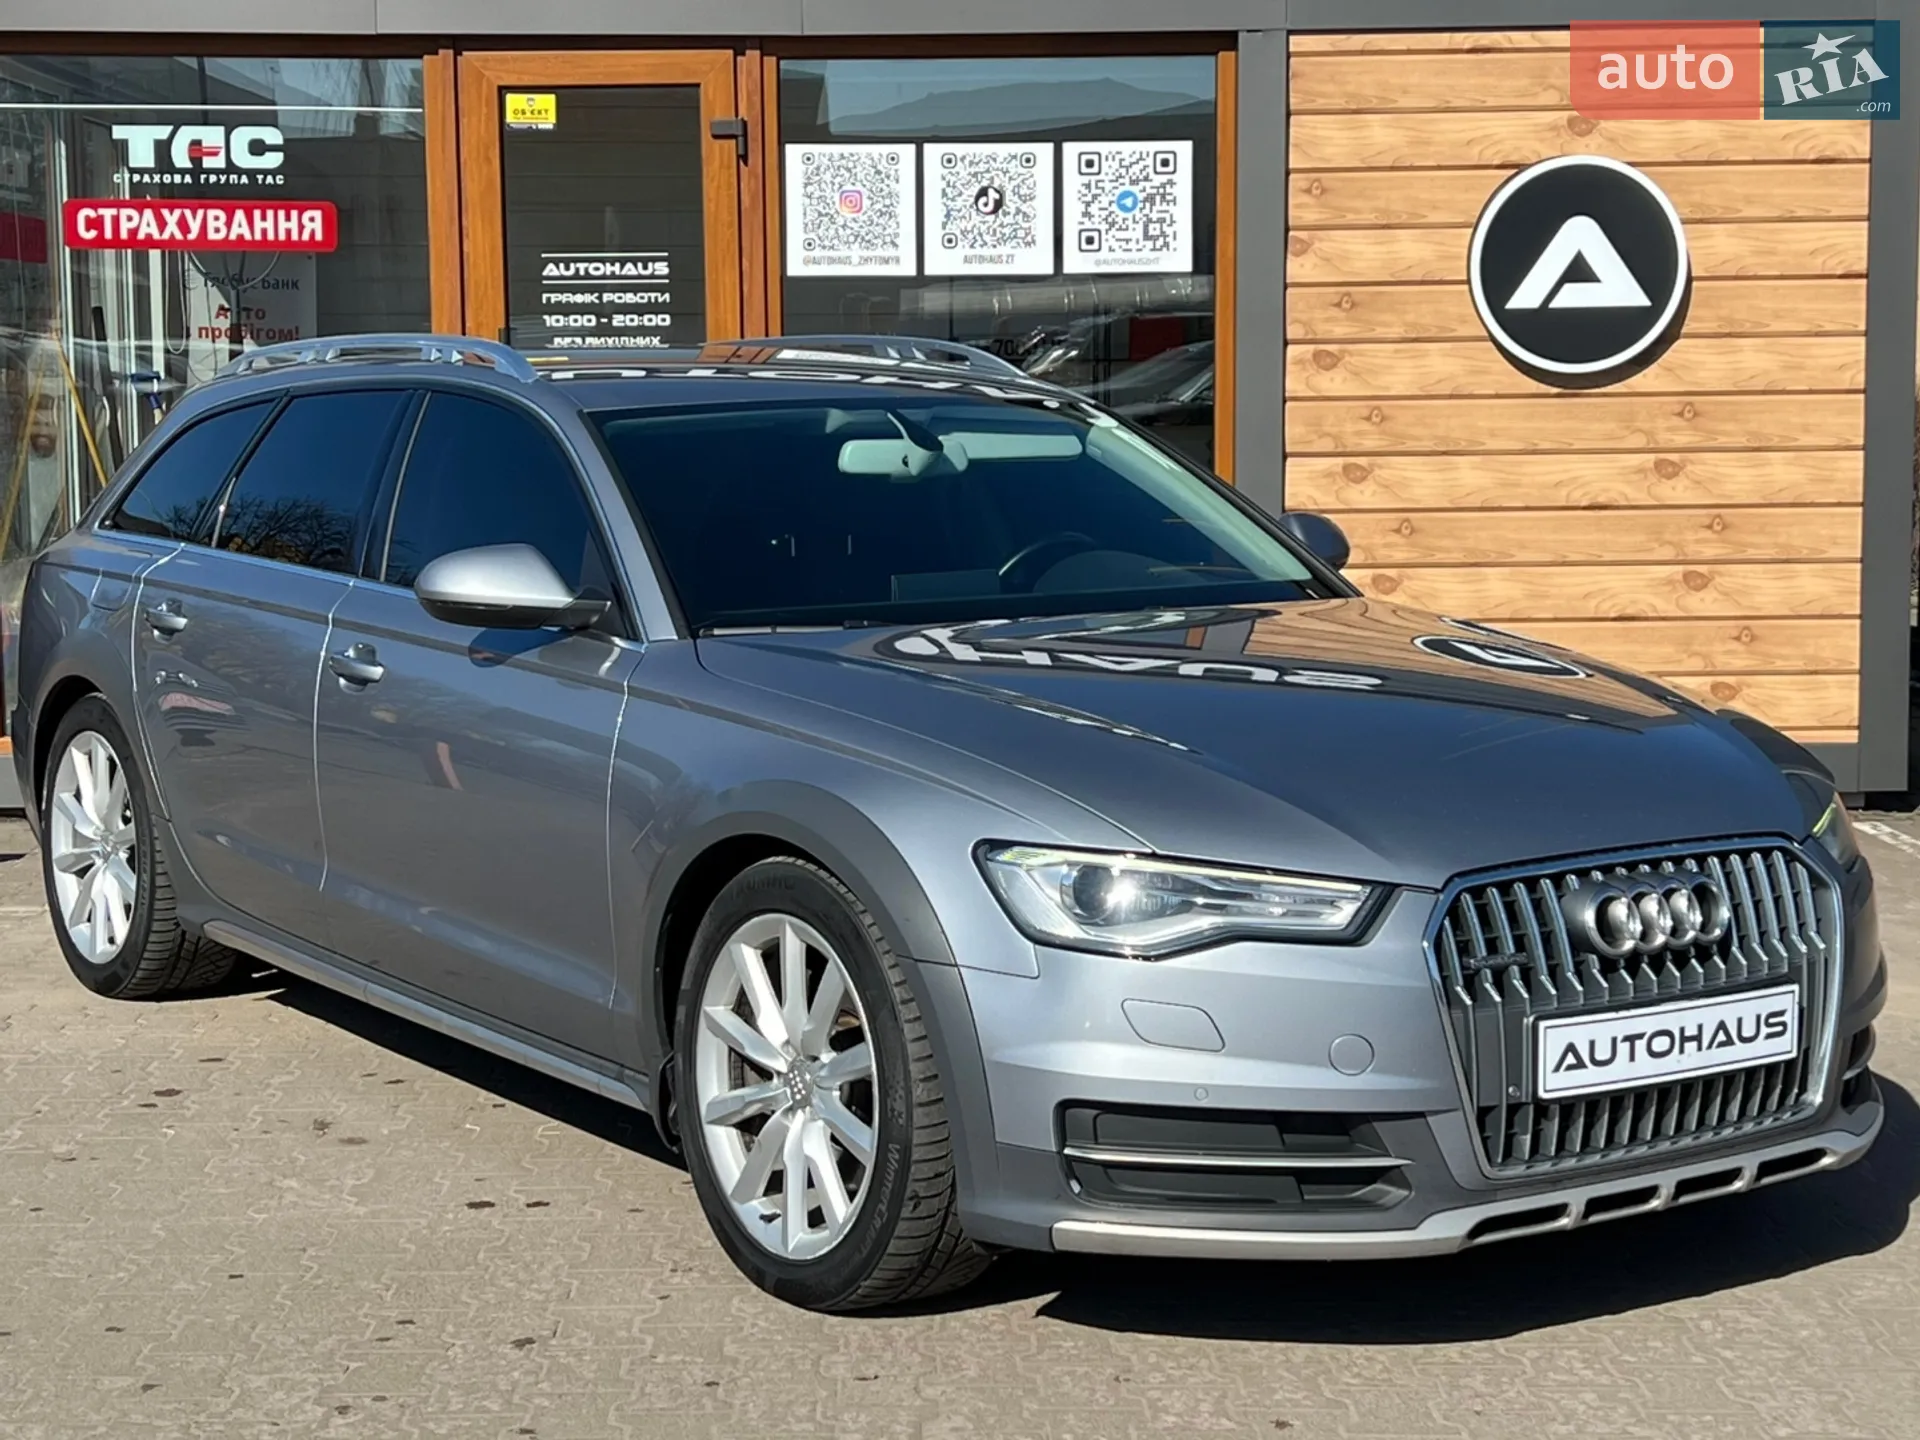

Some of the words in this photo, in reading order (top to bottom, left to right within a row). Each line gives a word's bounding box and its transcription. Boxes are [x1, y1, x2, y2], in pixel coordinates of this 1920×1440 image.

[112, 125, 284, 169] ТАС
[113, 173, 192, 184] СТРАХОВА
[200, 174, 249, 185] ГРУПА
[256, 174, 285, 185] ТАС
[76, 207, 322, 241] СТРАХУВАННЯ
[963, 254, 1003, 264] AUTOHAUS
[541, 262, 670, 276] AUTOHAUS
[542, 292, 599, 304] ГРАФІК
[602, 292, 670, 303] РОБОТИ
[215, 303, 267, 320] Ато
[543, 315, 597, 327] 10:00
[612, 314, 671, 326] 20:00
[1552, 1009, 1788, 1073] AUTOHAUS
